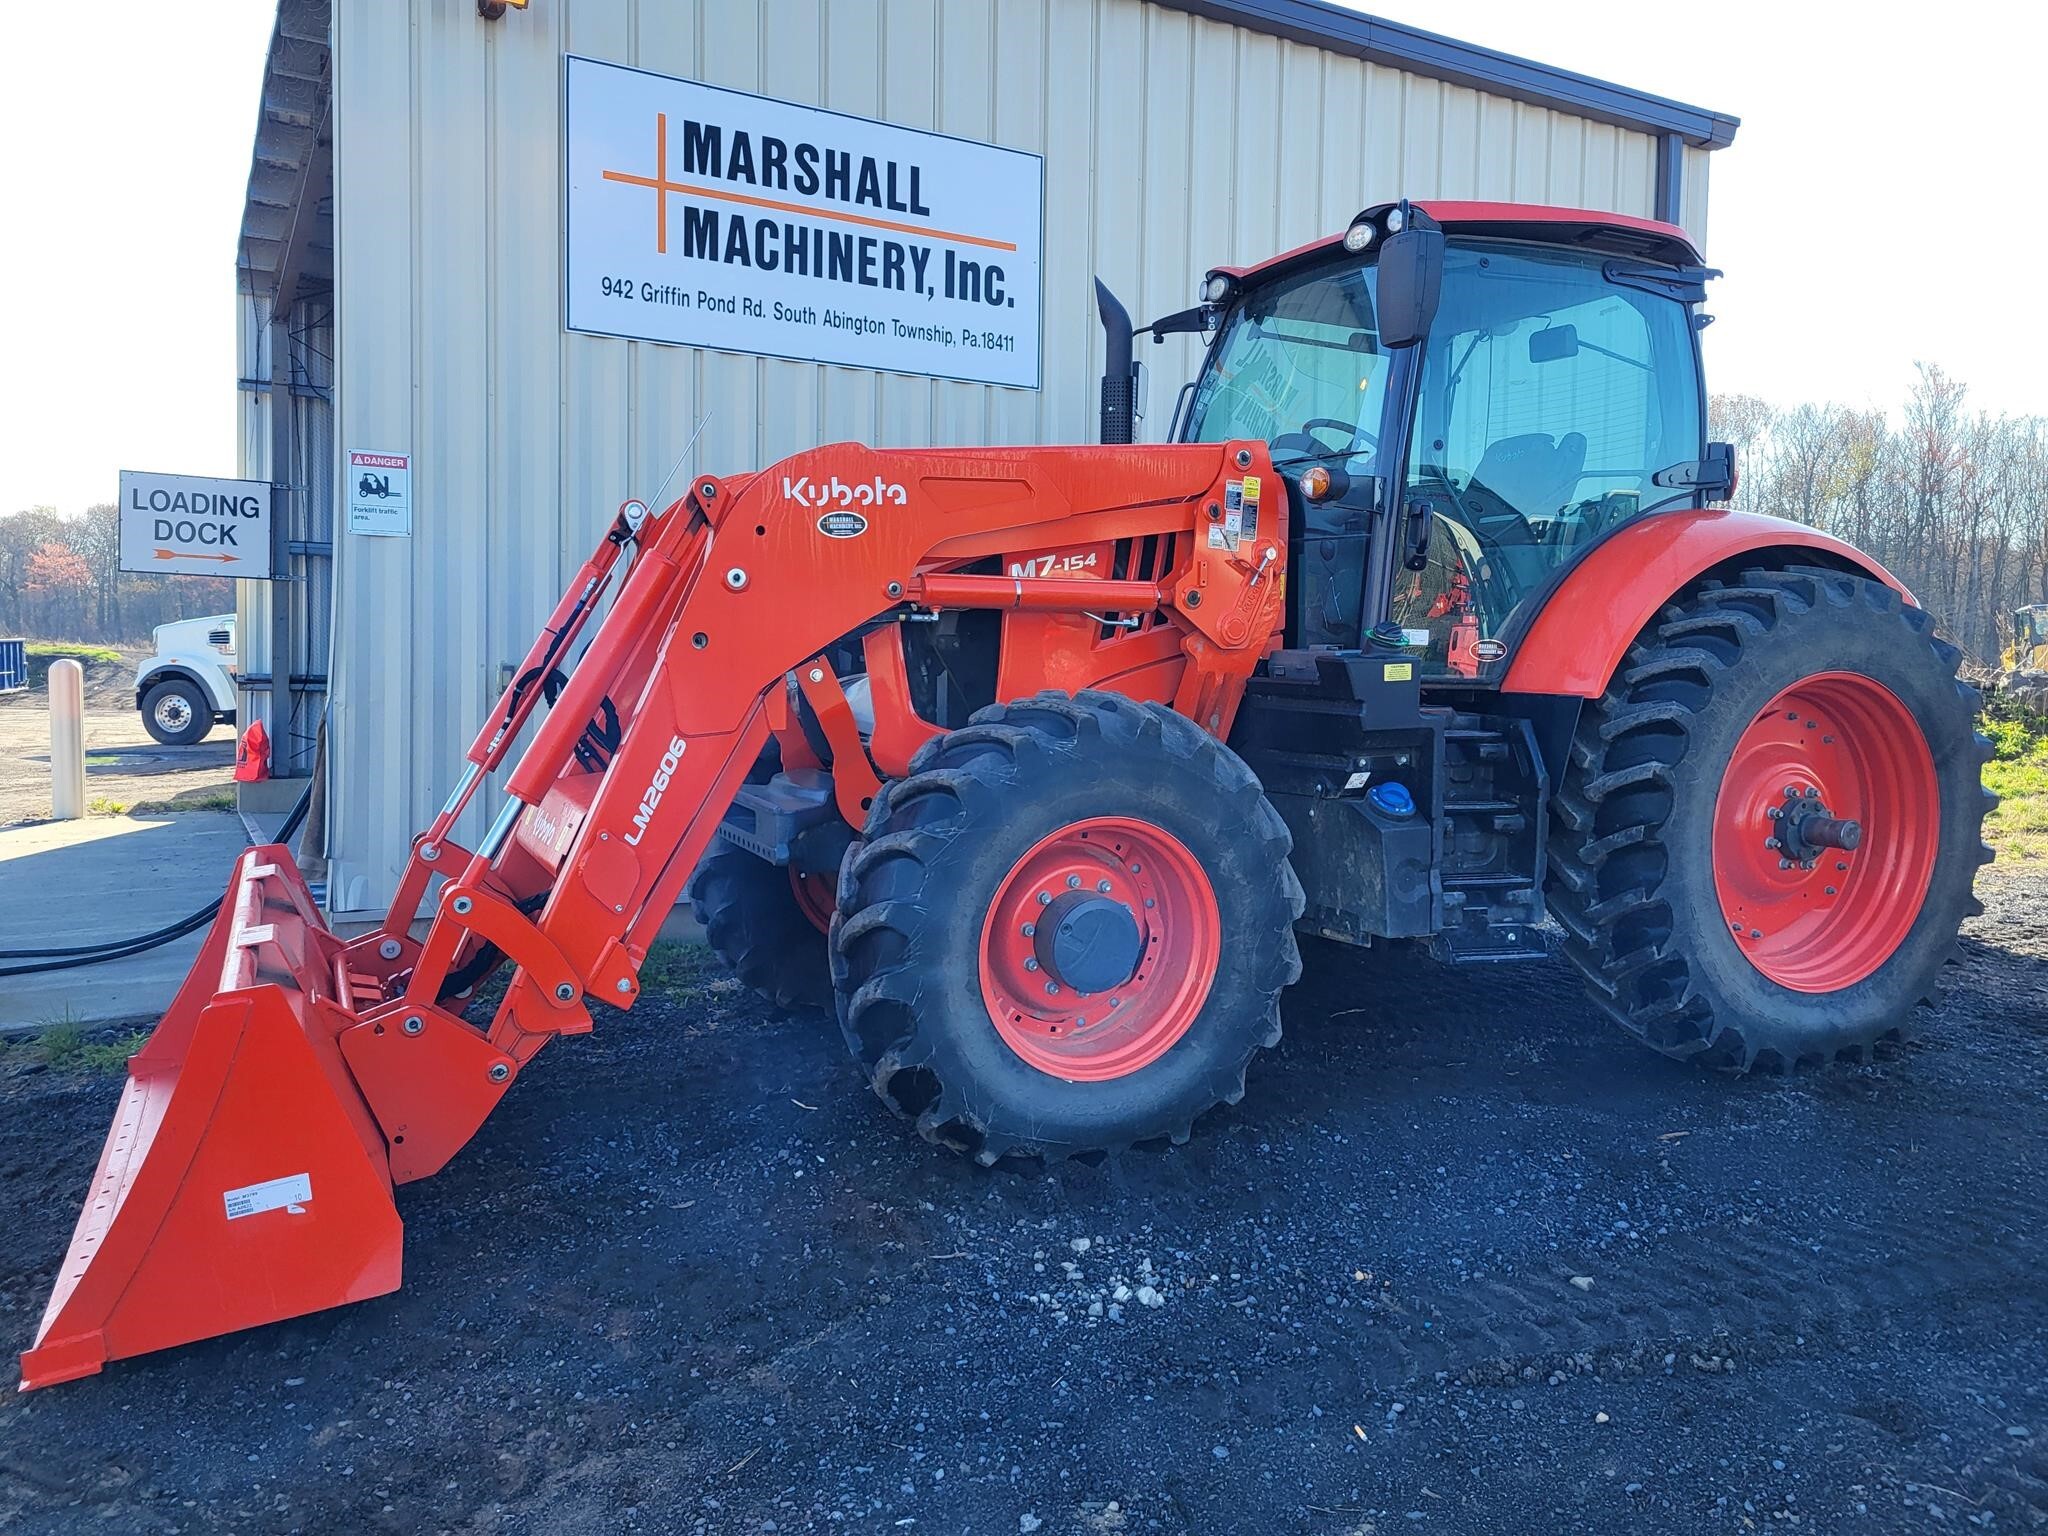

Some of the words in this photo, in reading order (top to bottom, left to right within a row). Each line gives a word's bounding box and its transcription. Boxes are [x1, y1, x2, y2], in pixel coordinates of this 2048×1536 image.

[683, 119, 930, 217] MARSHALL
[683, 205, 935, 302] MACHINERY,
[944, 248, 1015, 309] Inc.
[601, 276, 634, 300] 942
[641, 282, 690, 308] Griffin
[697, 290, 736, 314] Pond
[743, 297, 767, 319] Rd.
[773, 301, 816, 326] South
[823, 308, 885, 335] Abington
[891, 318, 957, 348] Township,
[364, 456, 404, 468] DANGER
[131, 487, 260, 520] LOADING
[783, 475, 907, 507] Kubota
[353, 506, 378, 515] Forklift
[153, 518, 239, 547] DOCK
[1010, 552, 1097, 578] M7-154
[623, 735, 688, 847] LM2606
